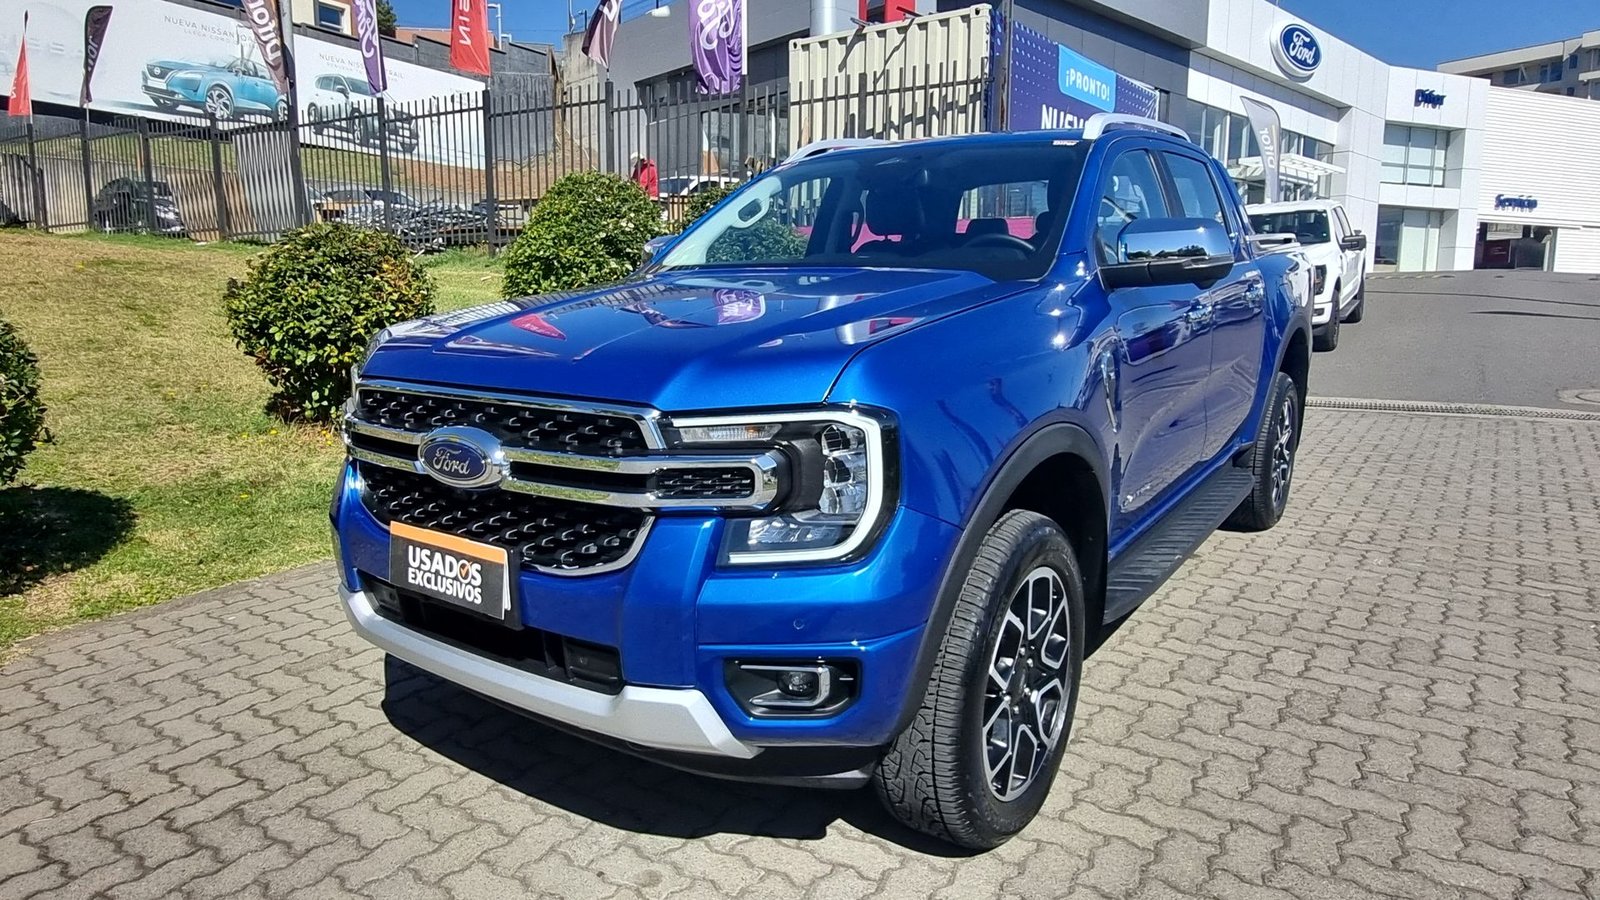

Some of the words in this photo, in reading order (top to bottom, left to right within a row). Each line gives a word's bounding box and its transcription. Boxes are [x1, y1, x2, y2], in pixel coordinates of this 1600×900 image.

[164, 15, 197, 29] NUEVA
[201, 24, 234, 38] NISSAN
[1289, 31, 1316, 64] Ford
[1065, 68, 1110, 101] ¡PRONTO!
[432, 447, 470, 475] Ford
[408, 545, 482, 587] USADOS
[407, 567, 482, 604] EXCLUSIVOS
